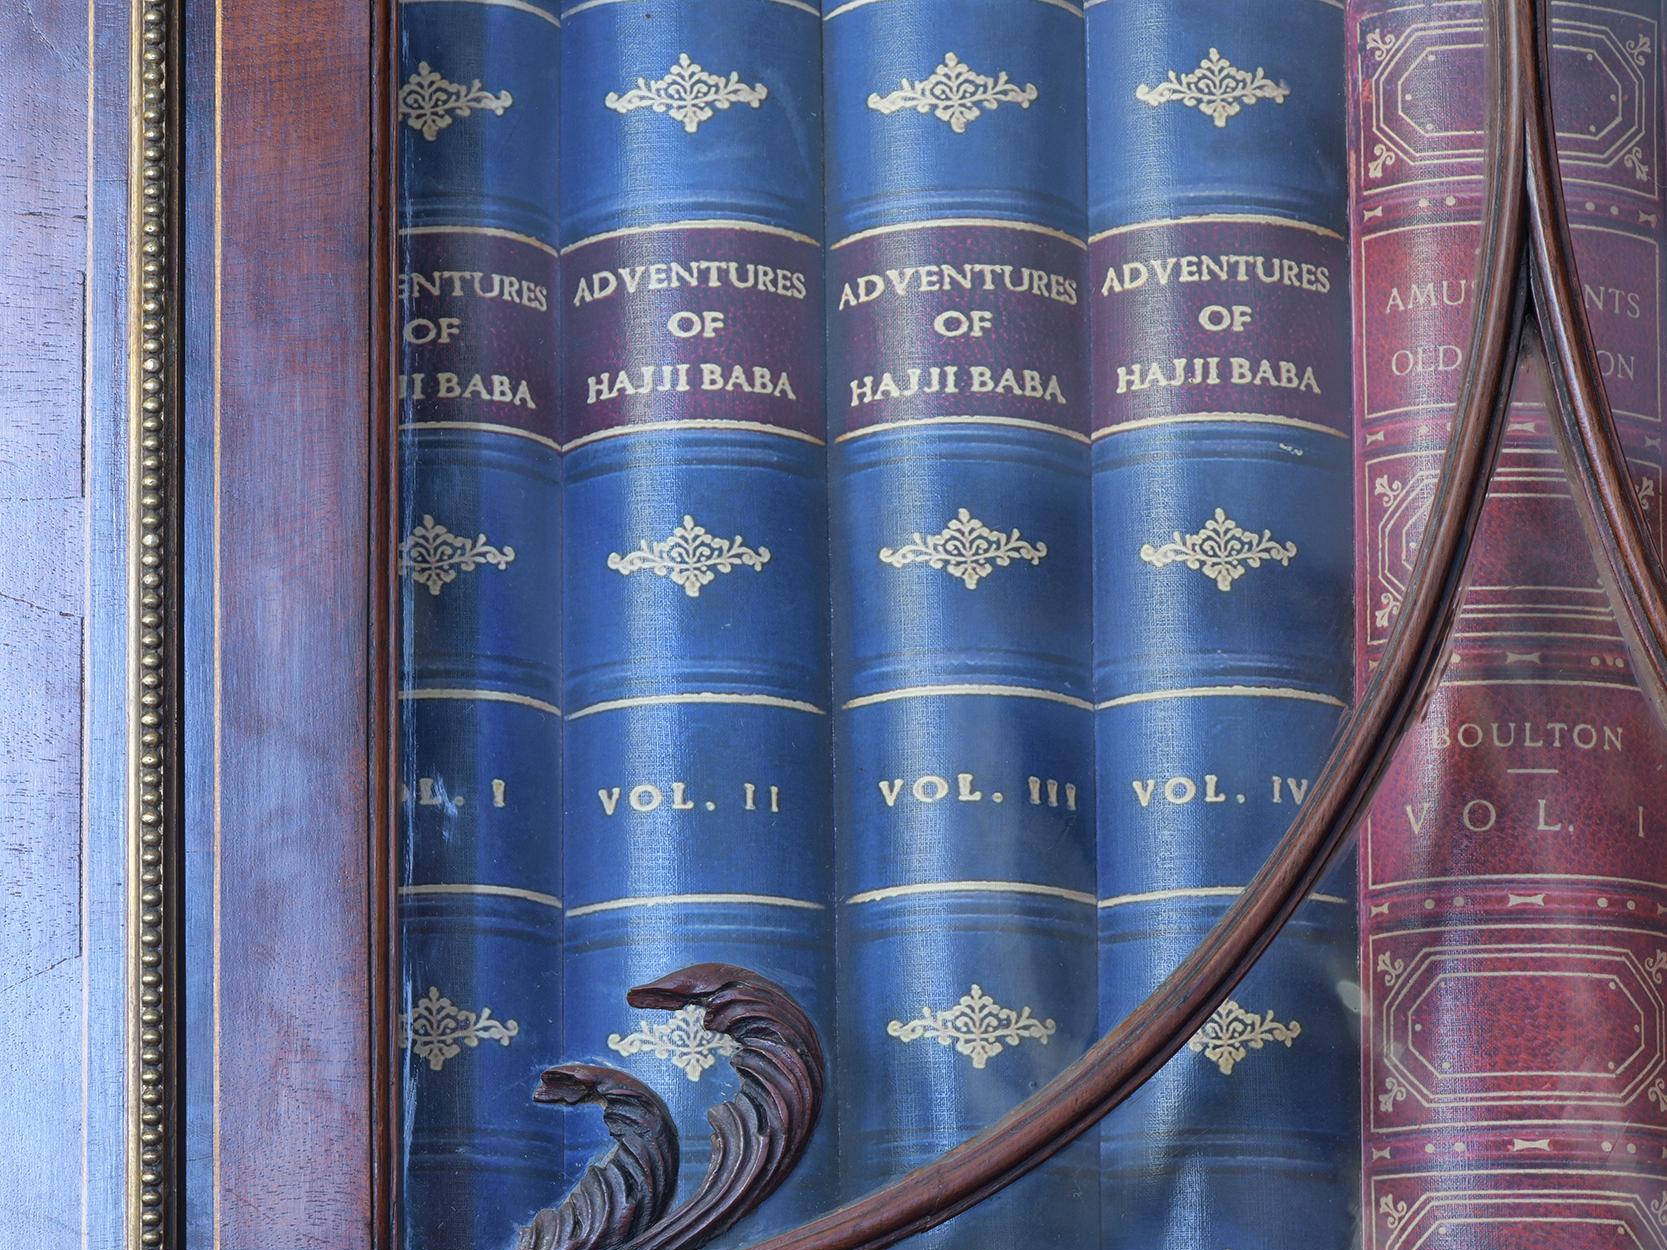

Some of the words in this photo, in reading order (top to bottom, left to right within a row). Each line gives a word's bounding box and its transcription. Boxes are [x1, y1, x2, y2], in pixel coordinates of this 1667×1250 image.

[573, 260, 807, 306] ADVENTURES
[838, 263, 1077, 311] ADVENTURES
[1101, 254, 1331, 296] ADVENTURES
[403, 317, 461, 344] OF
[667, 311, 724, 338] OF
[933, 309, 993, 338] OF
[1198, 304, 1252, 332] OF
[1116, 358, 1218, 394] HAJJI
[1230, 356, 1322, 394] BABA
[1391, 345, 1463, 376] OLD
[437, 372, 536, 409] BABA
[587, 365, 690, 404] HAJJI
[700, 362, 797, 400] BABA
[850, 365, 958, 407] HAJJI
[970, 366, 1067, 404] BABA
[1431, 722, 1623, 751] BOULTON
[491, 778, 505, 808] I
[598, 781, 716, 816] VOL.
[743, 783, 778, 812] II
[879, 773, 1004, 806] VOL.
[1028, 776, 1076, 811] III
[1132, 774, 1246, 807] VOL.
[1272, 775, 1308, 806] IV
